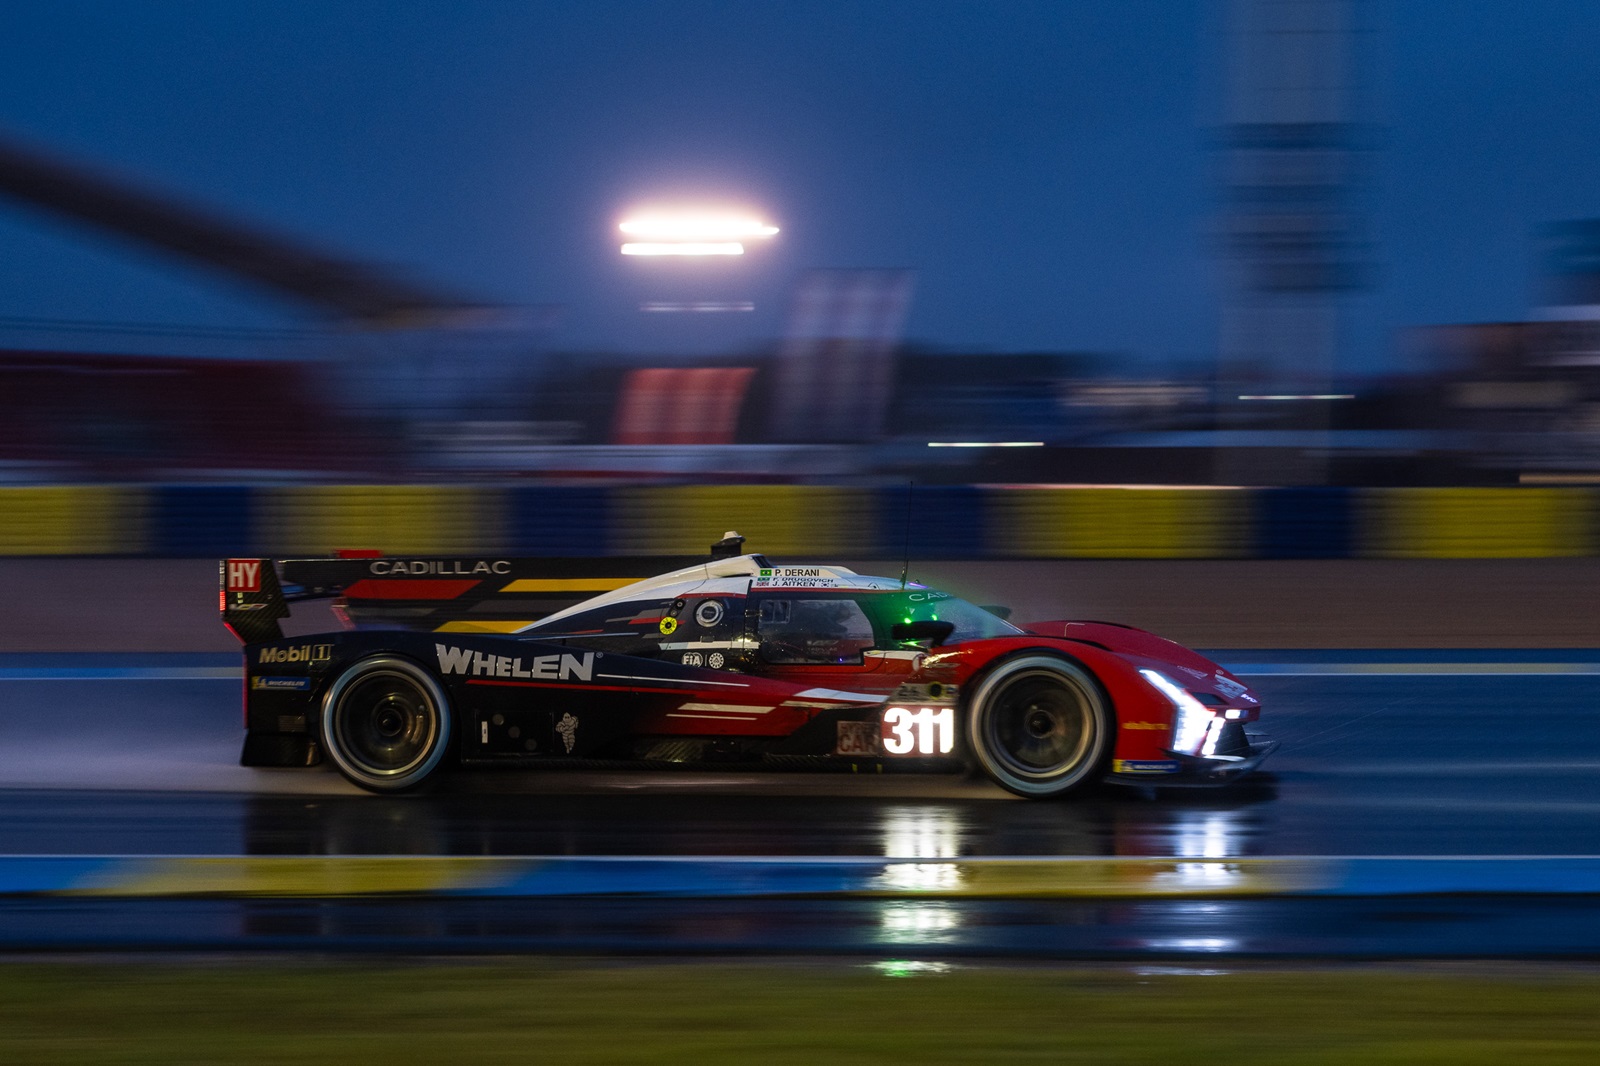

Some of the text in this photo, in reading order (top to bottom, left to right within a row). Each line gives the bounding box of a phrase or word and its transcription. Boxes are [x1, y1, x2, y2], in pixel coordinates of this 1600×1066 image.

[229, 562, 260, 588] HY
[369, 560, 512, 575] CADILLAC
[259, 645, 311, 664] Mobil
[435, 643, 595, 681] WHELEN
[883, 707, 954, 754] 311
